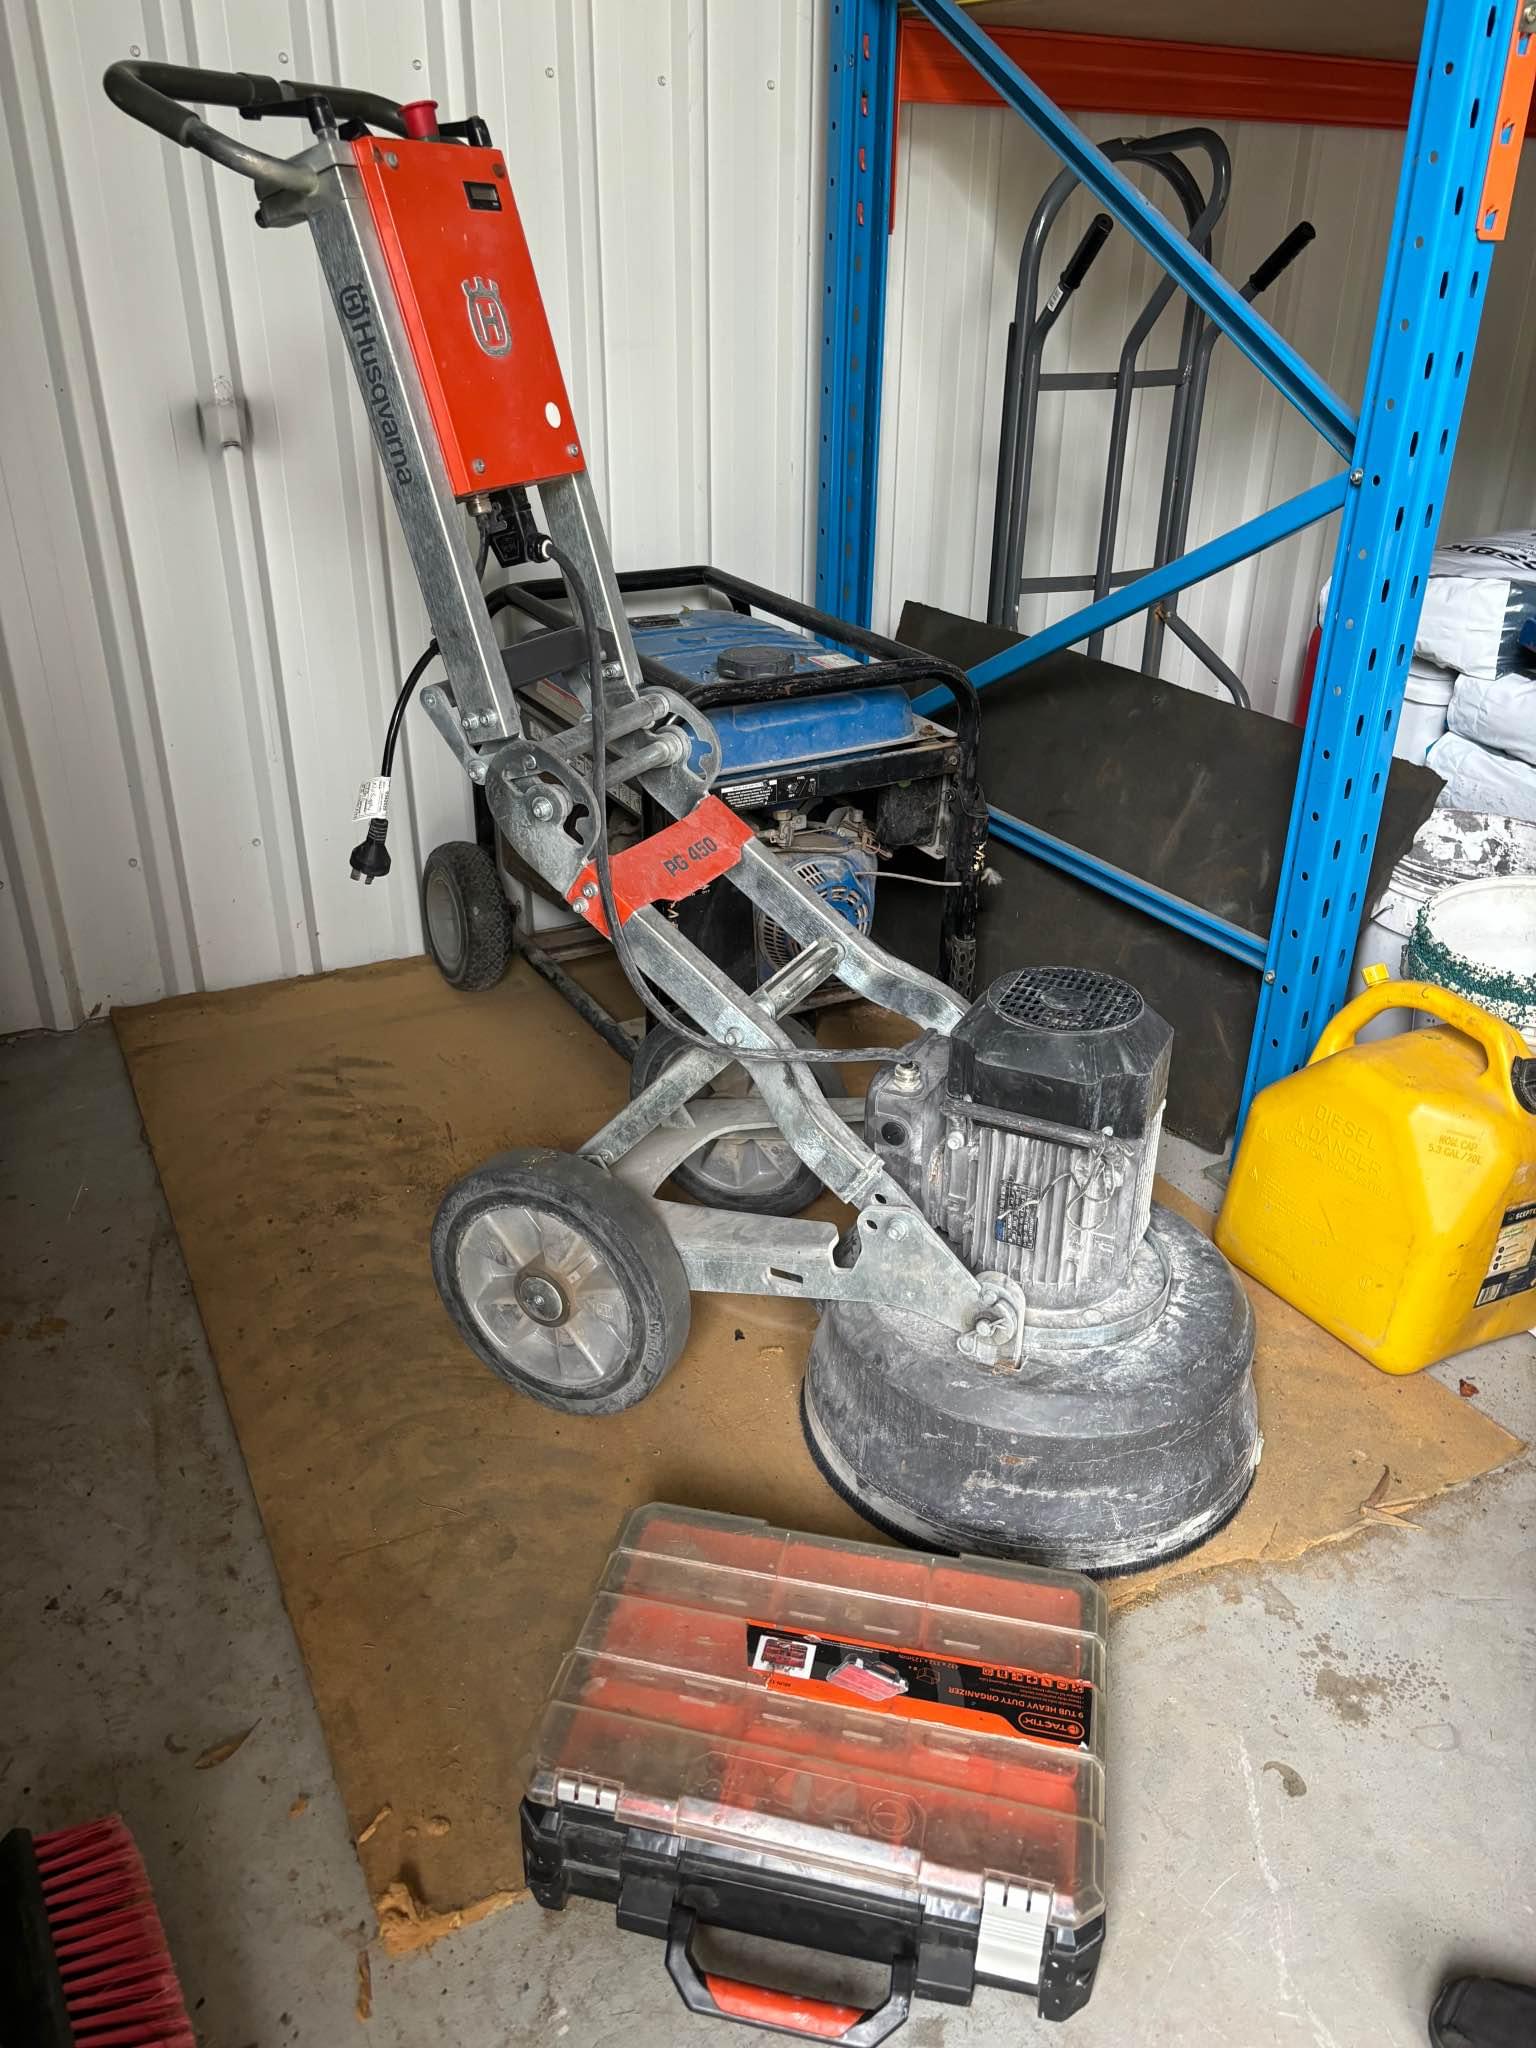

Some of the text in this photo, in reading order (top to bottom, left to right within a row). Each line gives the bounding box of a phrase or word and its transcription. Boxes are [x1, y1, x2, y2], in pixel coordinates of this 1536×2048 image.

[352, 321, 413, 486] Husqvarna
[664, 837, 717, 877] PG 450
[1314, 1104, 1377, 1152] DIESEL
[1308, 1126, 1383, 1175] DANGER
[948, 1687, 999, 1702] ORGANIZER
[1000, 1696, 1025, 1708] DUTY
[1027, 1701, 1057, 1714] HEAVY
[1058, 1708, 1076, 1717] TUB
[1023, 1717, 1068, 1732] TACTIX
